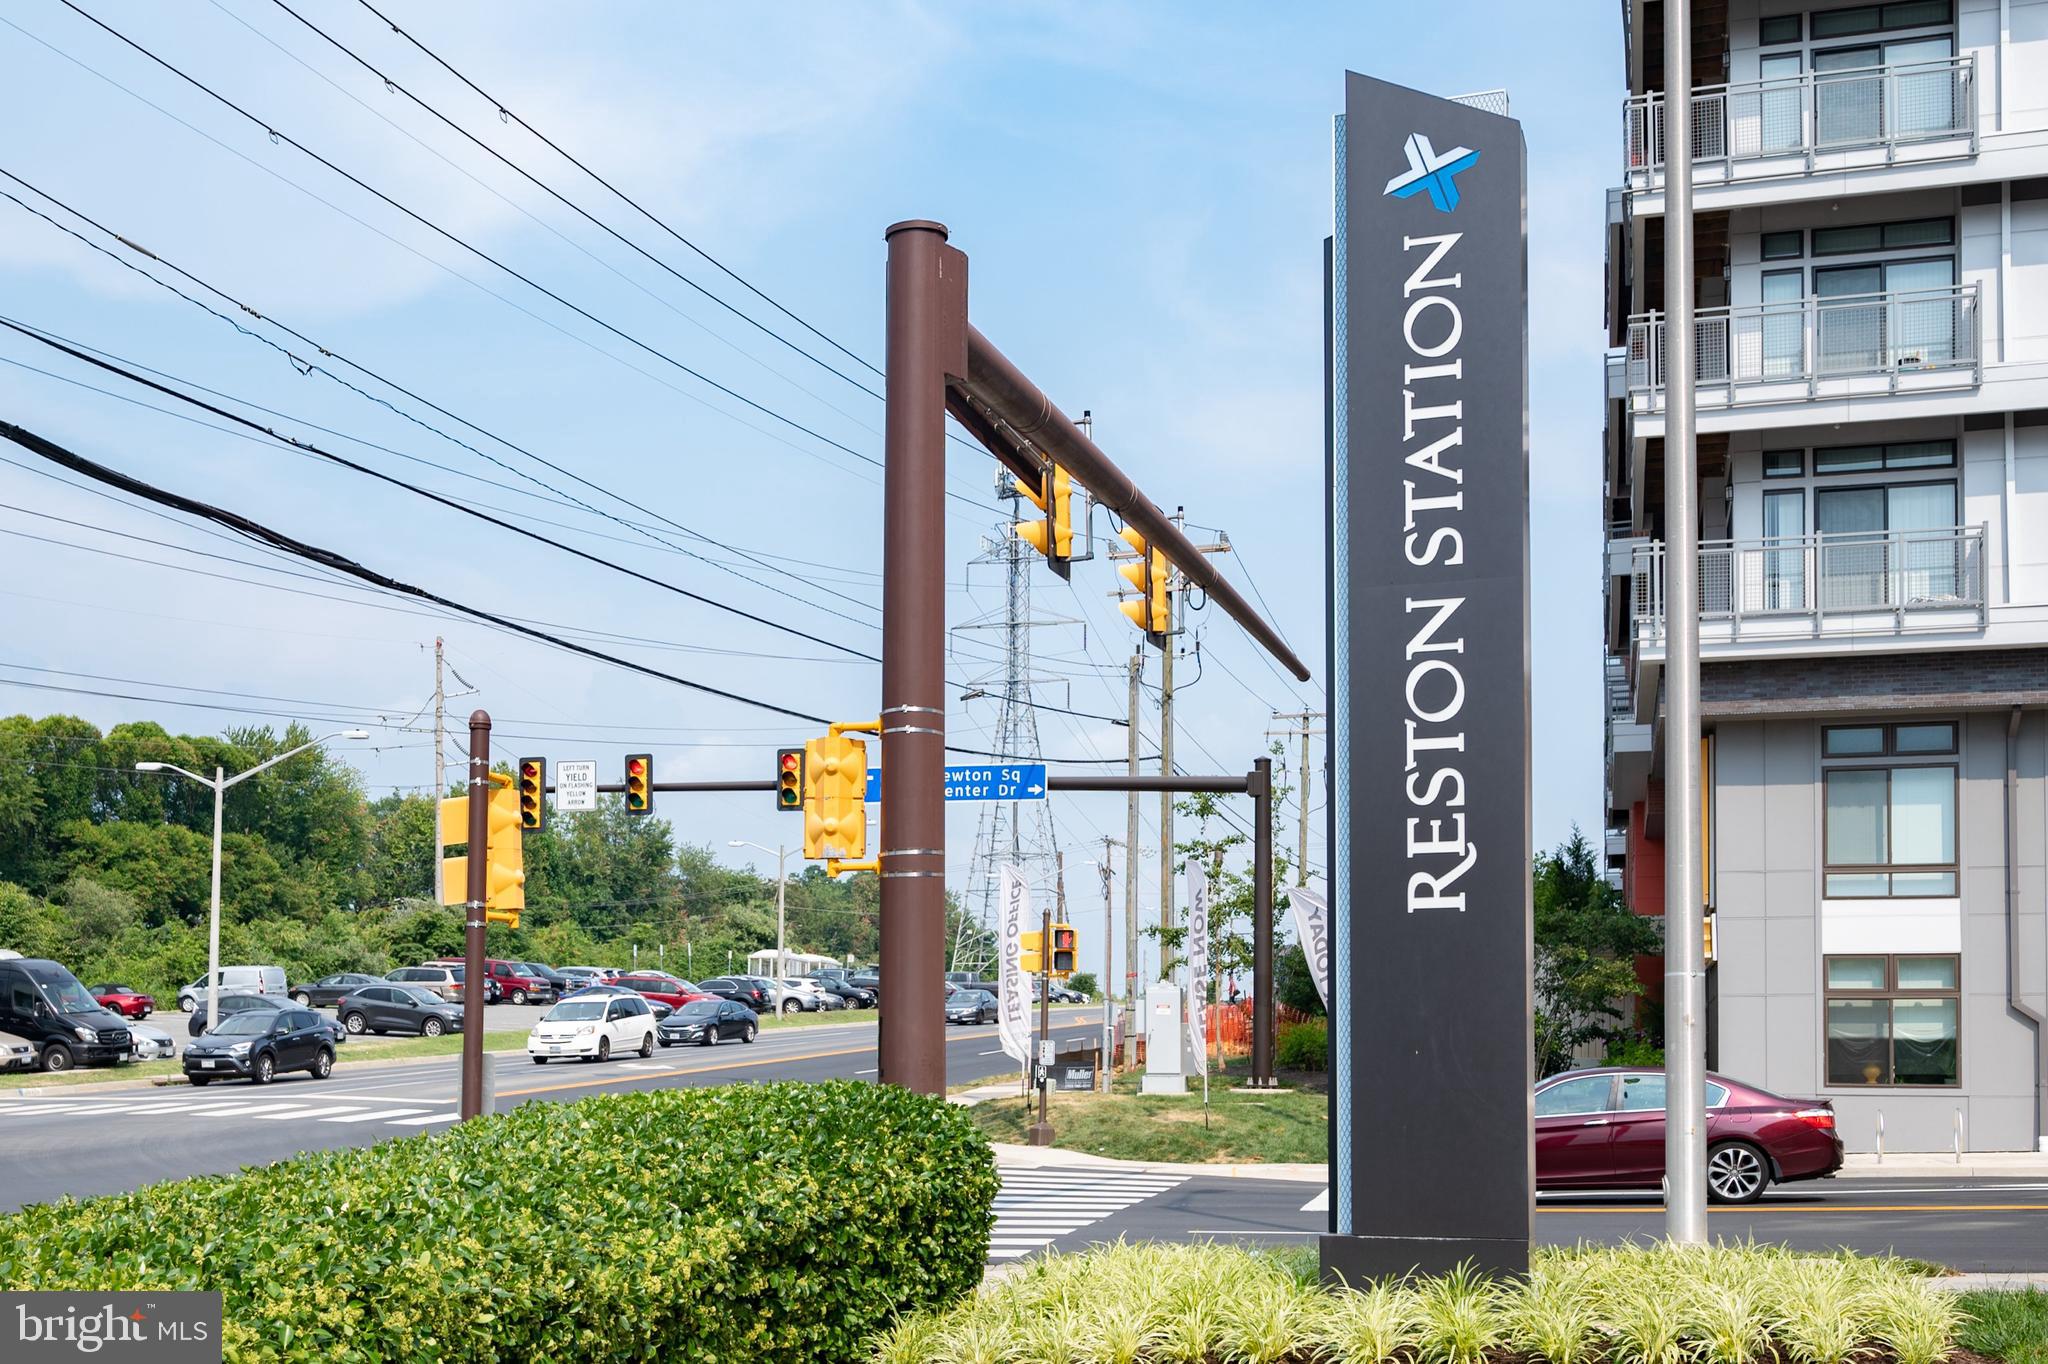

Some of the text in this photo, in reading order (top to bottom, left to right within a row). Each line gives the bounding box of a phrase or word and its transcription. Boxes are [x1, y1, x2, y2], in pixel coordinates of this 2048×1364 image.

[1402, 232, 1478, 914] RESTON STATION
[565, 773, 588, 781] YIELD
[945, 769, 1021, 783] ewton Sq
[945, 784, 1017, 797] enter Dr
[1067, 1069, 1091, 1079] Muller
